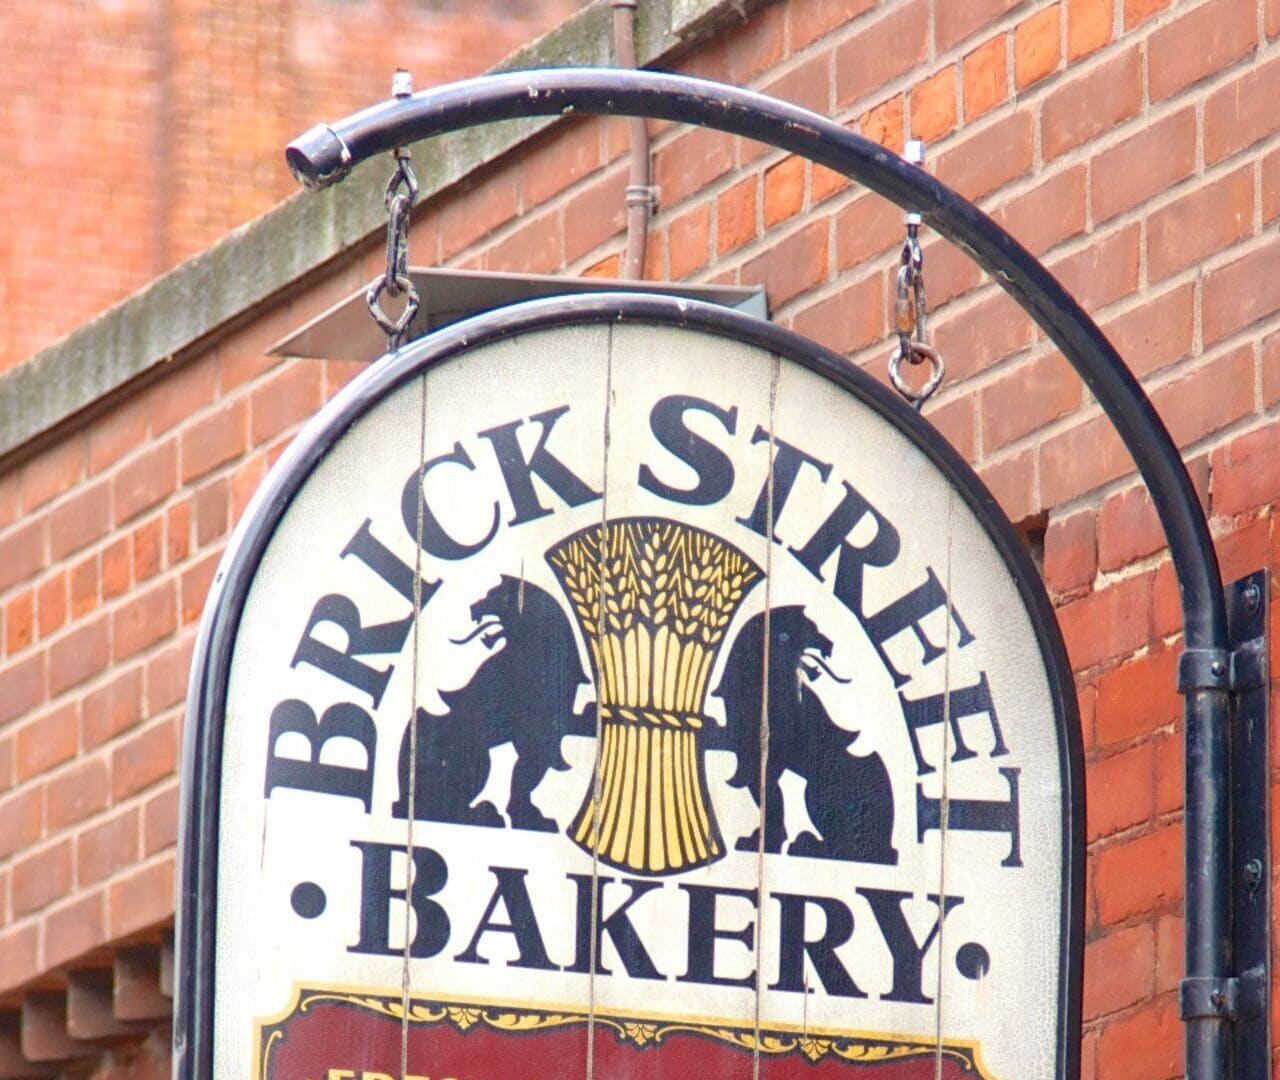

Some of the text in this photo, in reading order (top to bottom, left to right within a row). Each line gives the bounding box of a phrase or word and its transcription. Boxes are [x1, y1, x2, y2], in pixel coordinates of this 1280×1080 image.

[264, 393, 1024, 868] BRICK STREET
[347, 839, 965, 1005] BAKERY
